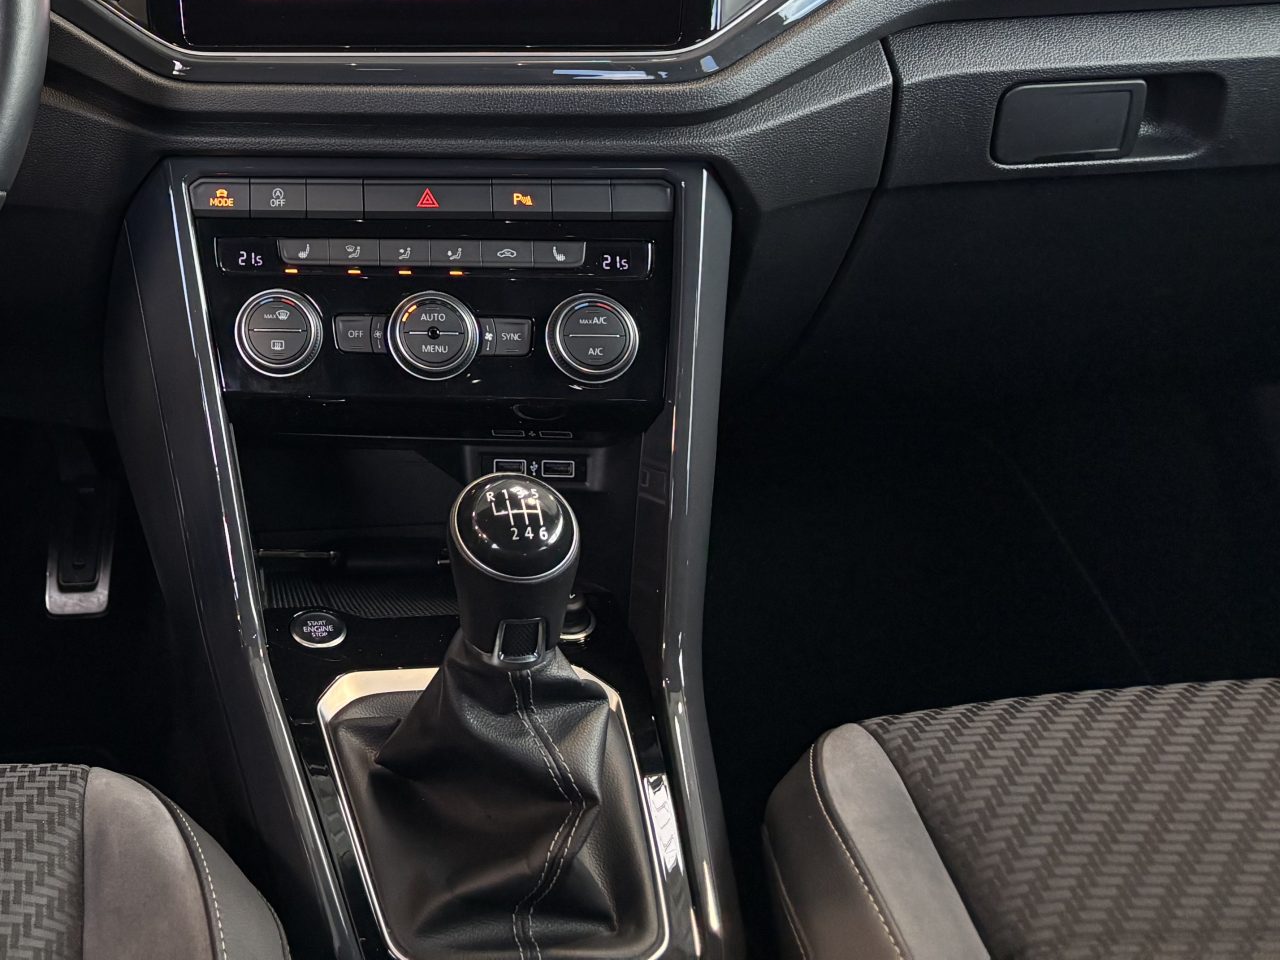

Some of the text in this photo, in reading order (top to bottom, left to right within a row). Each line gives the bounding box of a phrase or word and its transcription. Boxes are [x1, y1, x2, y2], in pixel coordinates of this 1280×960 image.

[209, 197, 234, 207] MODE
[269, 199, 286, 207] OFF
[420, 313, 446, 322] AUTO
[592, 316, 607, 325] A/C
[347, 330, 364, 339] OFF
[501, 333, 522, 341] SYNC
[421, 344, 449, 354] MENU
[587, 347, 604, 356] A/C
[486, 488, 539, 502] R 1 5
[510, 526, 549, 540] 2 4 6
[302, 625, 334, 633] ENGINE
